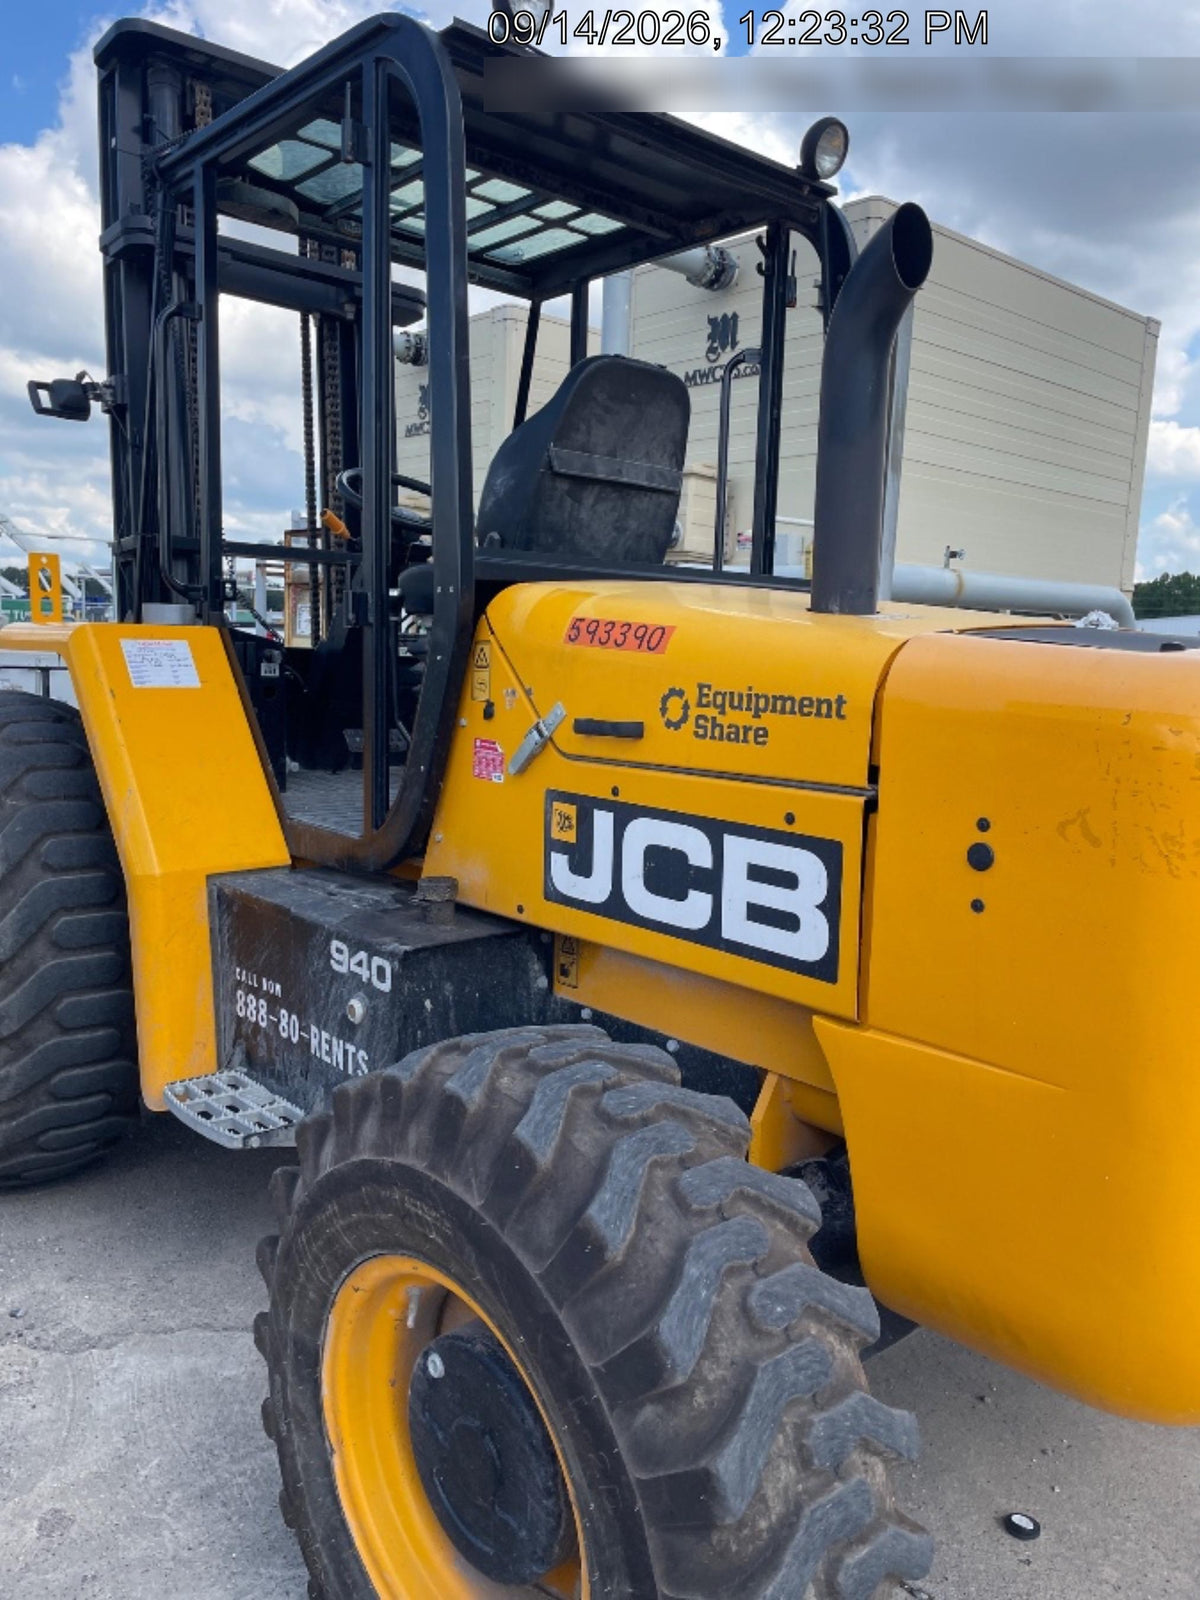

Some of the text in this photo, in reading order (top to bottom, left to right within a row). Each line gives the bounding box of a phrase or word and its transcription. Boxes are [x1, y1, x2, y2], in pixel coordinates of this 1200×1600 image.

[568, 617, 666, 652] 593390
[696, 682, 847, 721] Equipment
[693, 714, 769, 746] Share
[550, 808, 830, 963] JCB
[235, 966, 259, 988] CALL
[329, 939, 392, 993] 940
[236, 989, 369, 1077] 888-80-RENTS
